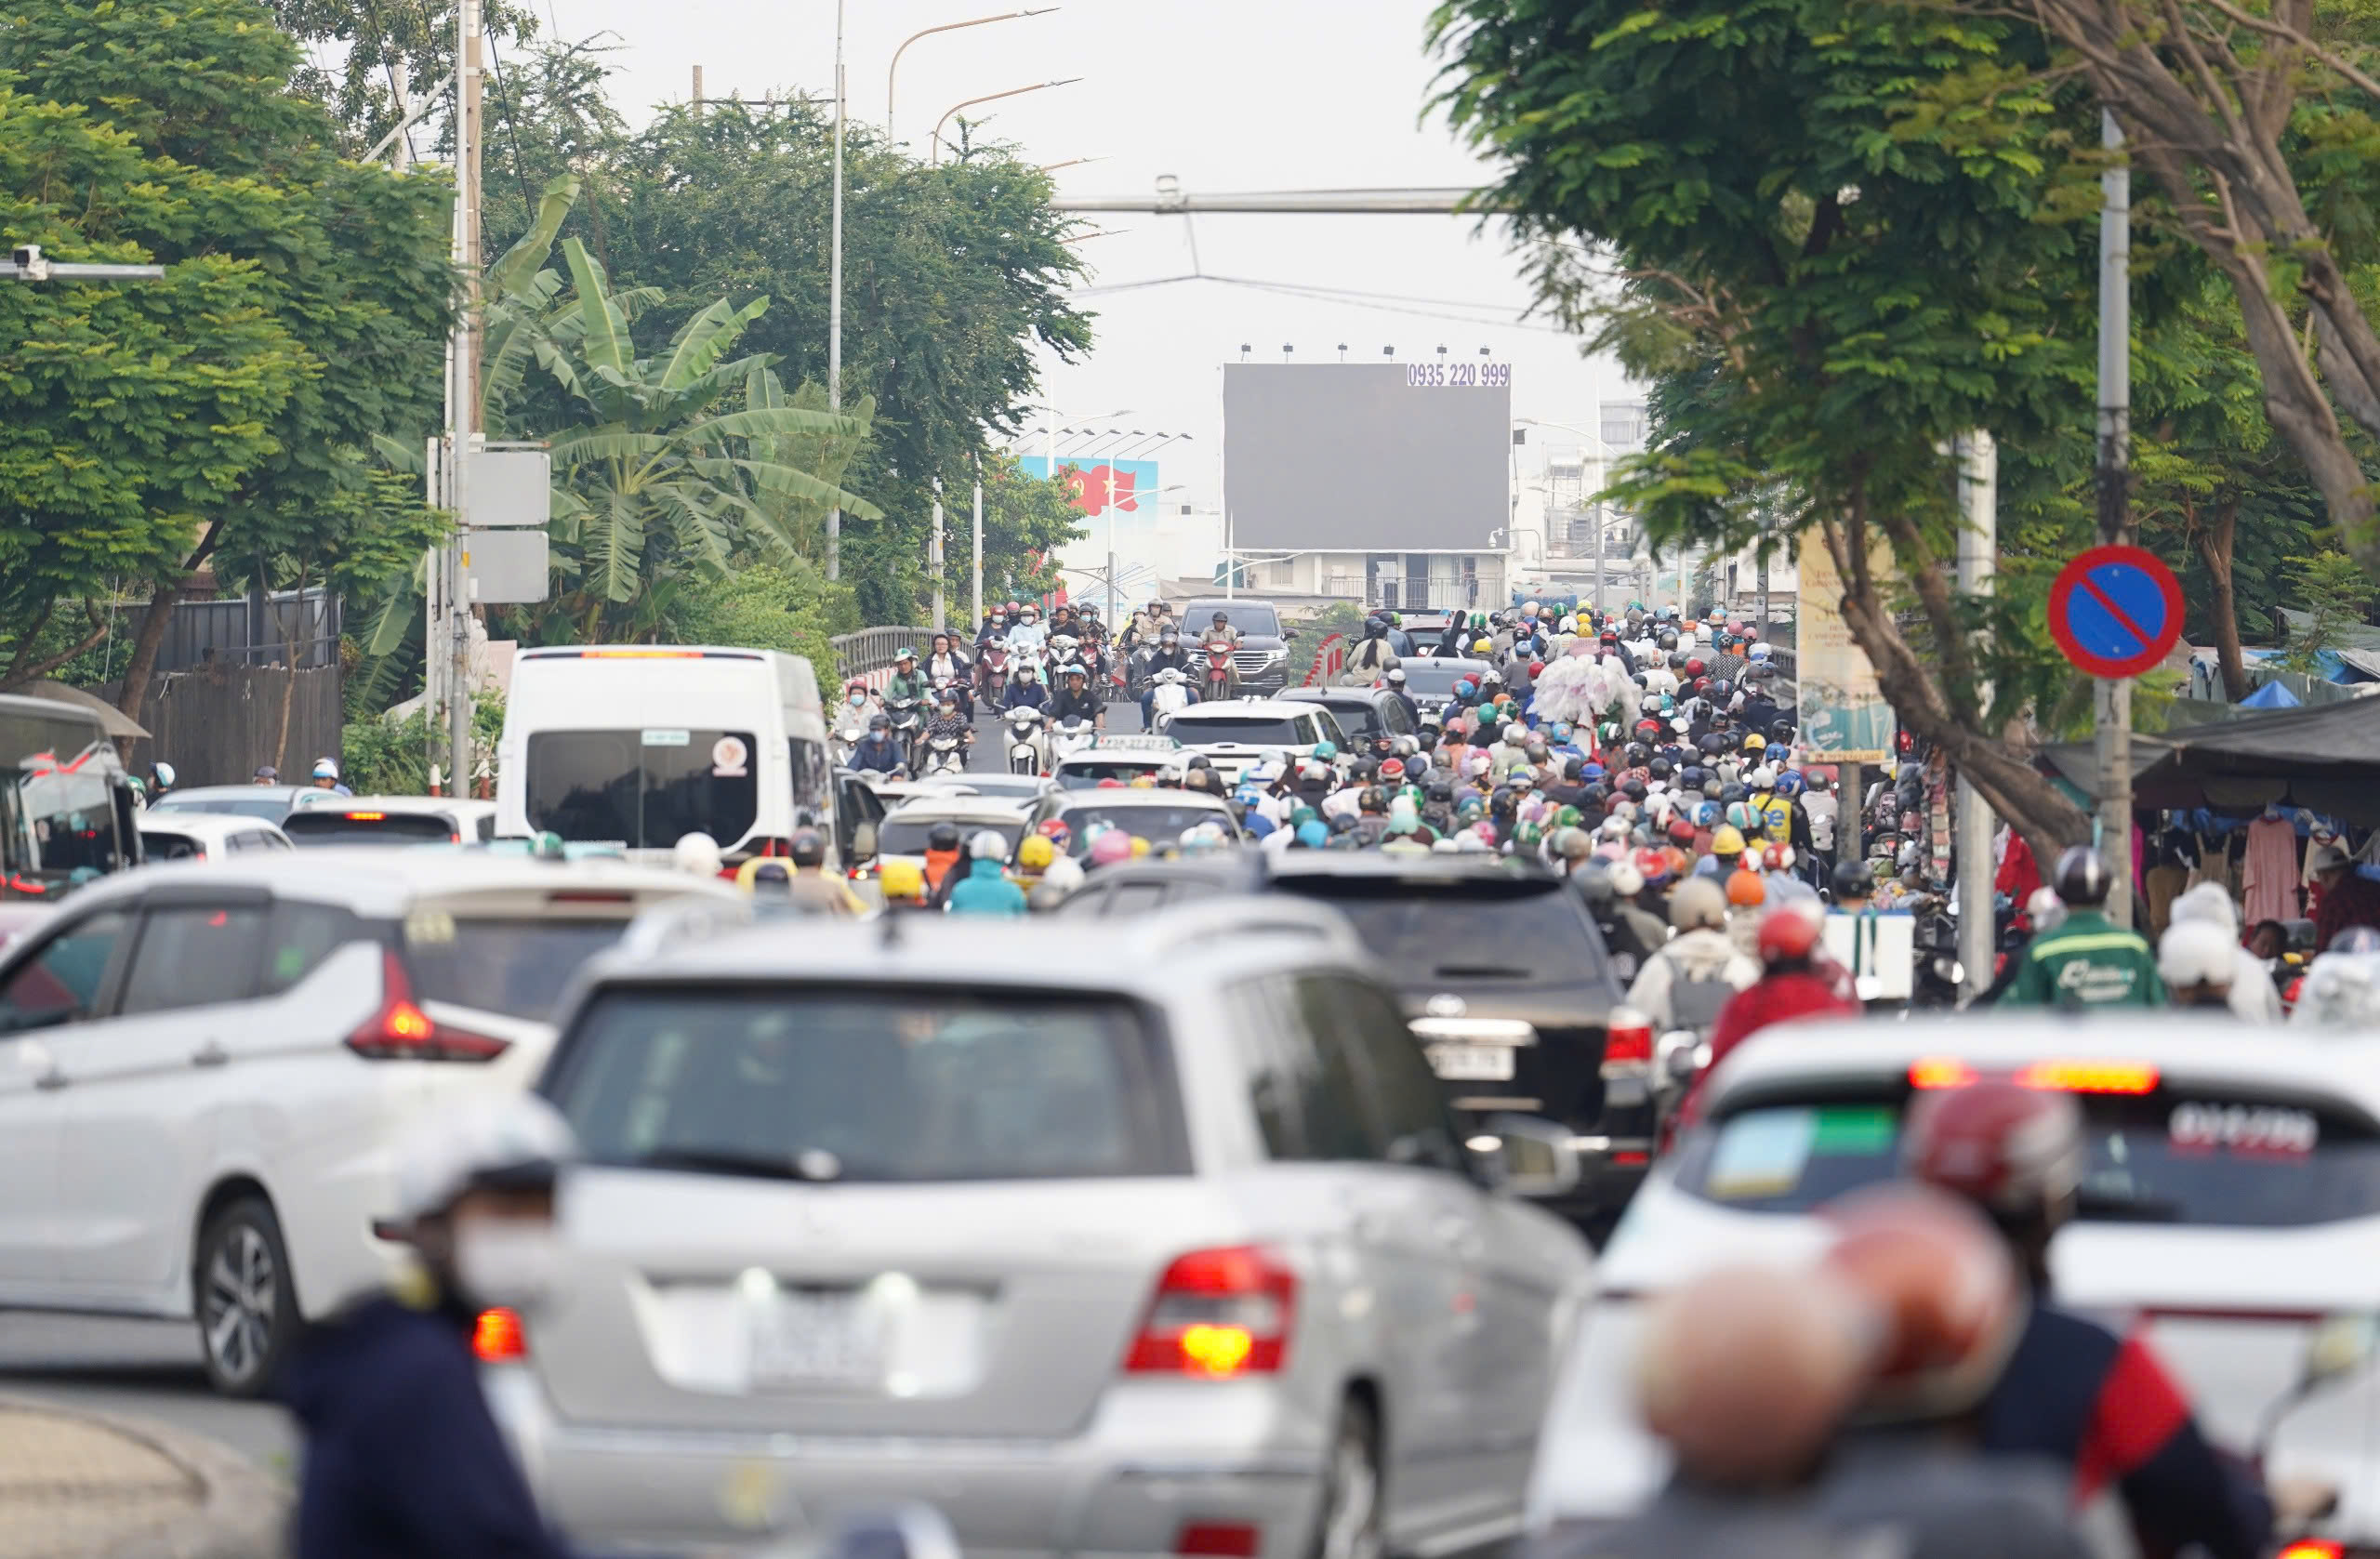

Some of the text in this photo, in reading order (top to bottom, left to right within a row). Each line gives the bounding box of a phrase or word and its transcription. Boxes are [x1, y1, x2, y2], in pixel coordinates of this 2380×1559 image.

[1408, 363, 1508, 386] 0935 220 999
